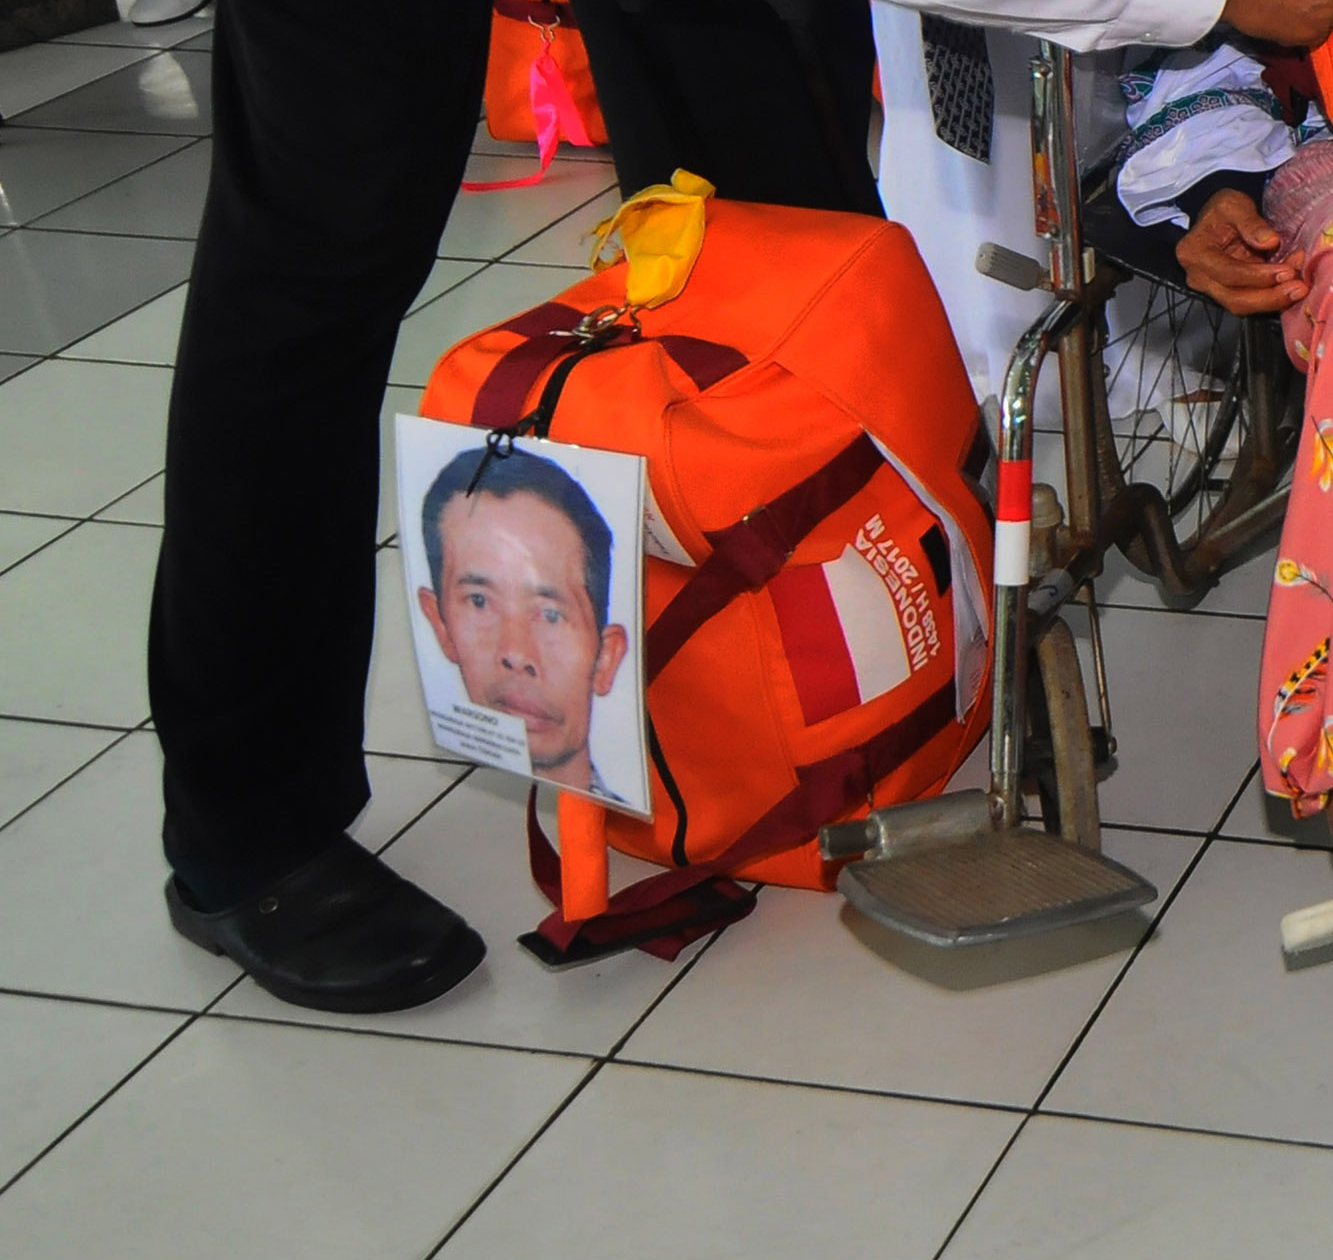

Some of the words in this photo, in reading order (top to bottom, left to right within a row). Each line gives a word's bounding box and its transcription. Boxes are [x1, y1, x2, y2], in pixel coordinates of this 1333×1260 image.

[865, 513, 885, 540] M
[876, 539, 919, 585] 2017
[855, 528, 928, 671] INDONESIA
[915, 591, 930, 613] H
[922, 610, 941, 657] 1438
